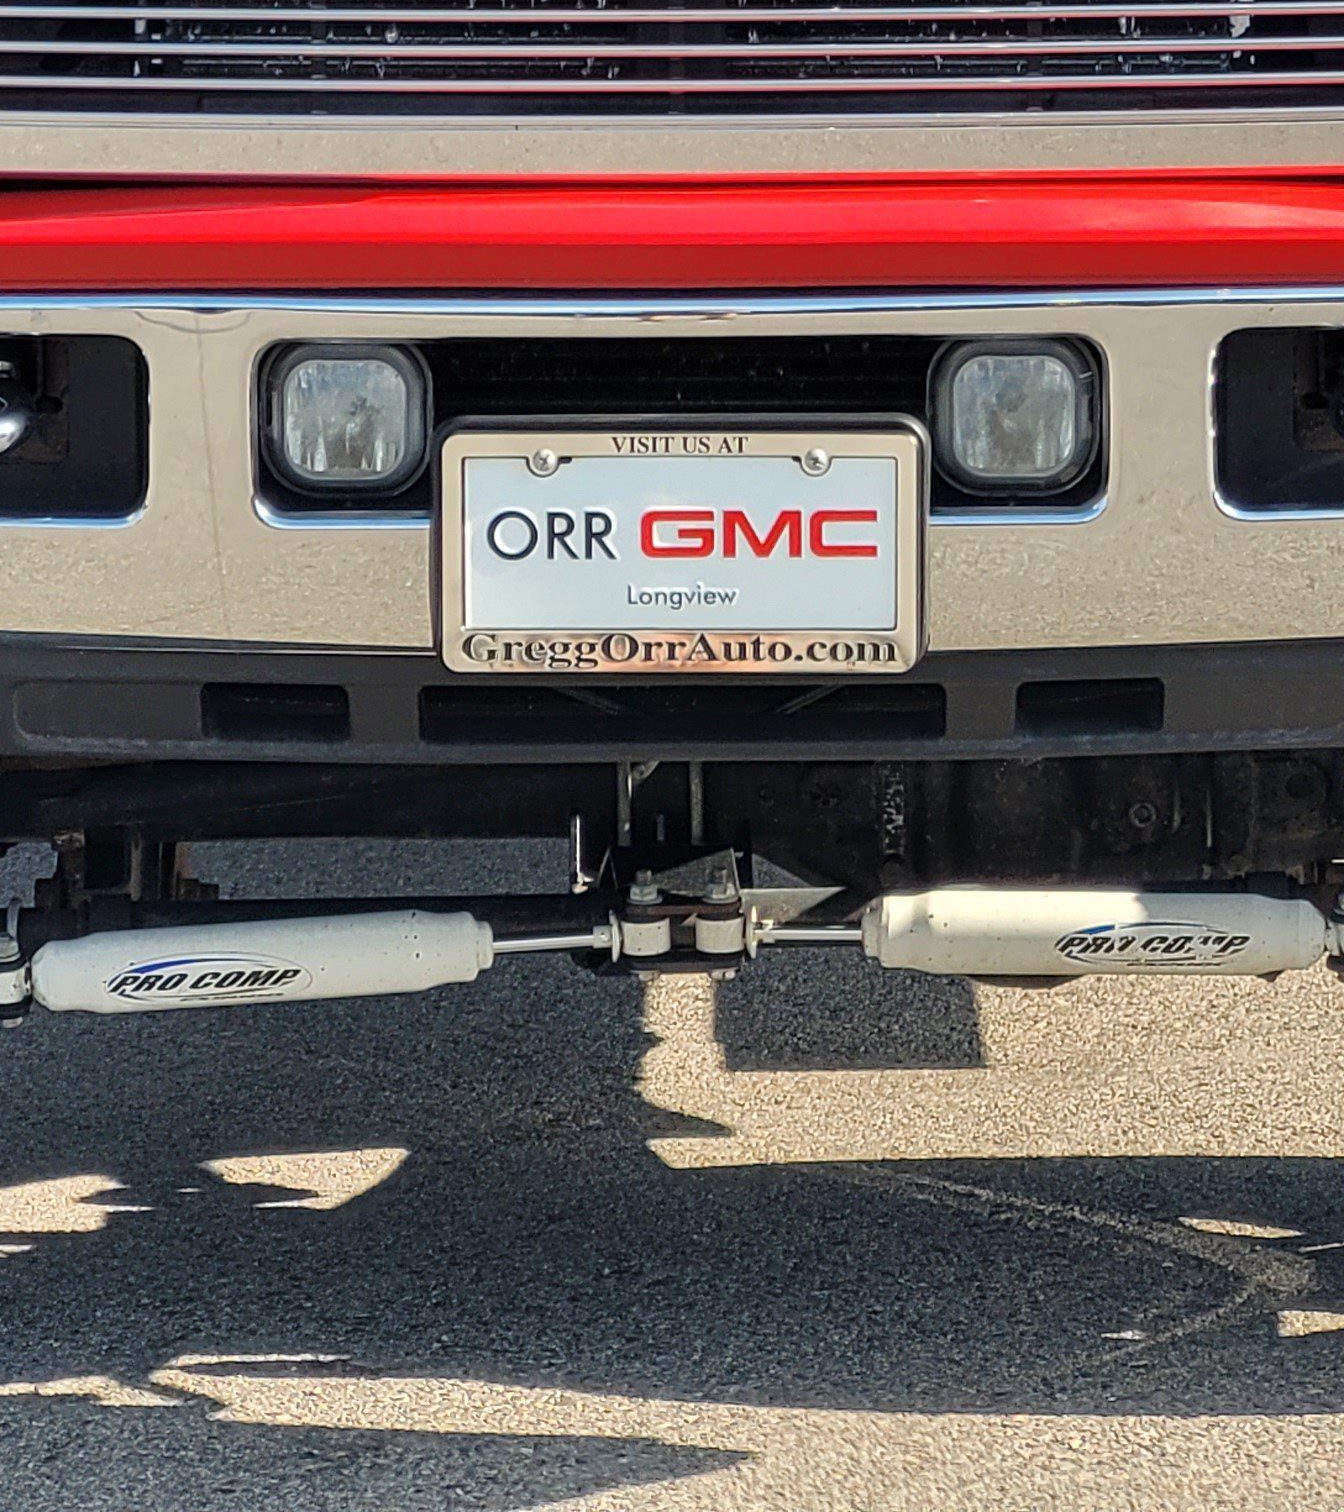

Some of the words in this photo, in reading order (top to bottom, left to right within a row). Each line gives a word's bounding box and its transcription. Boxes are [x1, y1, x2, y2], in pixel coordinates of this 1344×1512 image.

[611, 436, 676, 454] VISIT
[681, 436, 711, 454] US
[716, 436, 749, 454] AT
[486, 510, 618, 561] ORR
[640, 509, 878, 559] GMC
[627, 584, 737, 610] Longview
[461, 633, 898, 669] GreggOrrAuto.com
[109, 973, 188, 994] PRO
[189, 968, 302, 988] COMP
